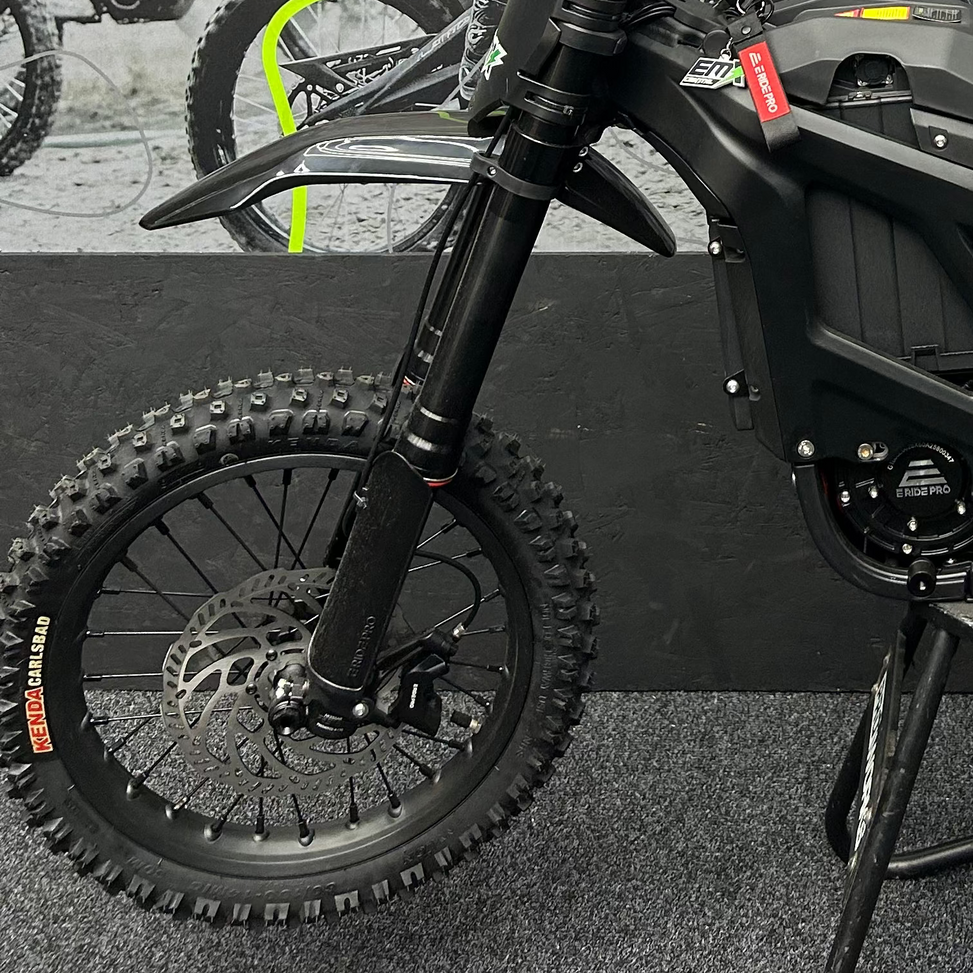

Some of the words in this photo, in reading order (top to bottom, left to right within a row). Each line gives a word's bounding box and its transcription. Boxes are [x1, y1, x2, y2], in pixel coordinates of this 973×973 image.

[763, 91, 779, 114] PRO
[929, 484, 951, 495] PRO
[28, 615, 51, 687] CARLSBAD
[25, 686, 53, 753] KENDA
